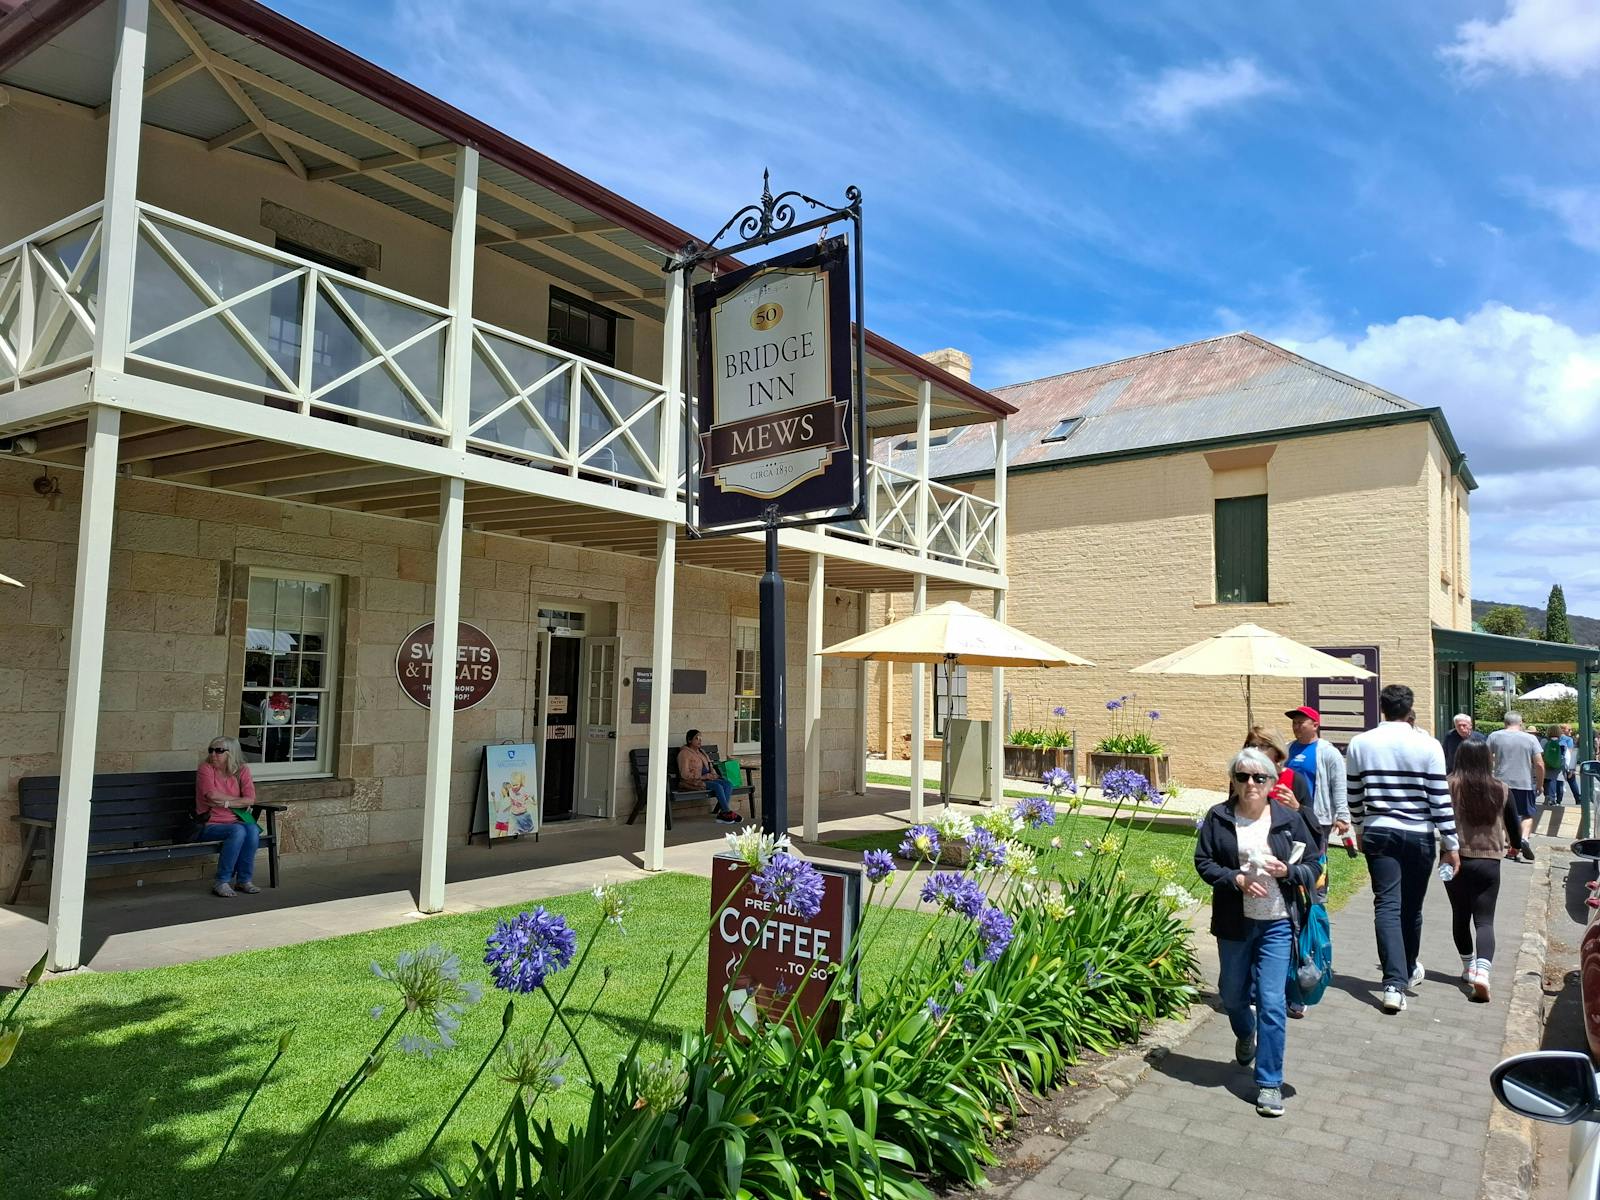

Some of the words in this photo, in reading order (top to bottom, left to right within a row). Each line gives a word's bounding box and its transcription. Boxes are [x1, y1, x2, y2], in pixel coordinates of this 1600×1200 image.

[756, 308, 777, 325] 50
[725, 332, 815, 378] BRIDGE
[748, 373, 796, 408] INN
[731, 413, 814, 456] MEWS
[750, 470, 774, 480] CIRCA
[410, 643, 491, 662] SWETS
[405, 662, 420, 678] &
[421, 662, 492, 680] TATS
[719, 906, 831, 963] COFFEE
[809, 967, 828, 981] GO
